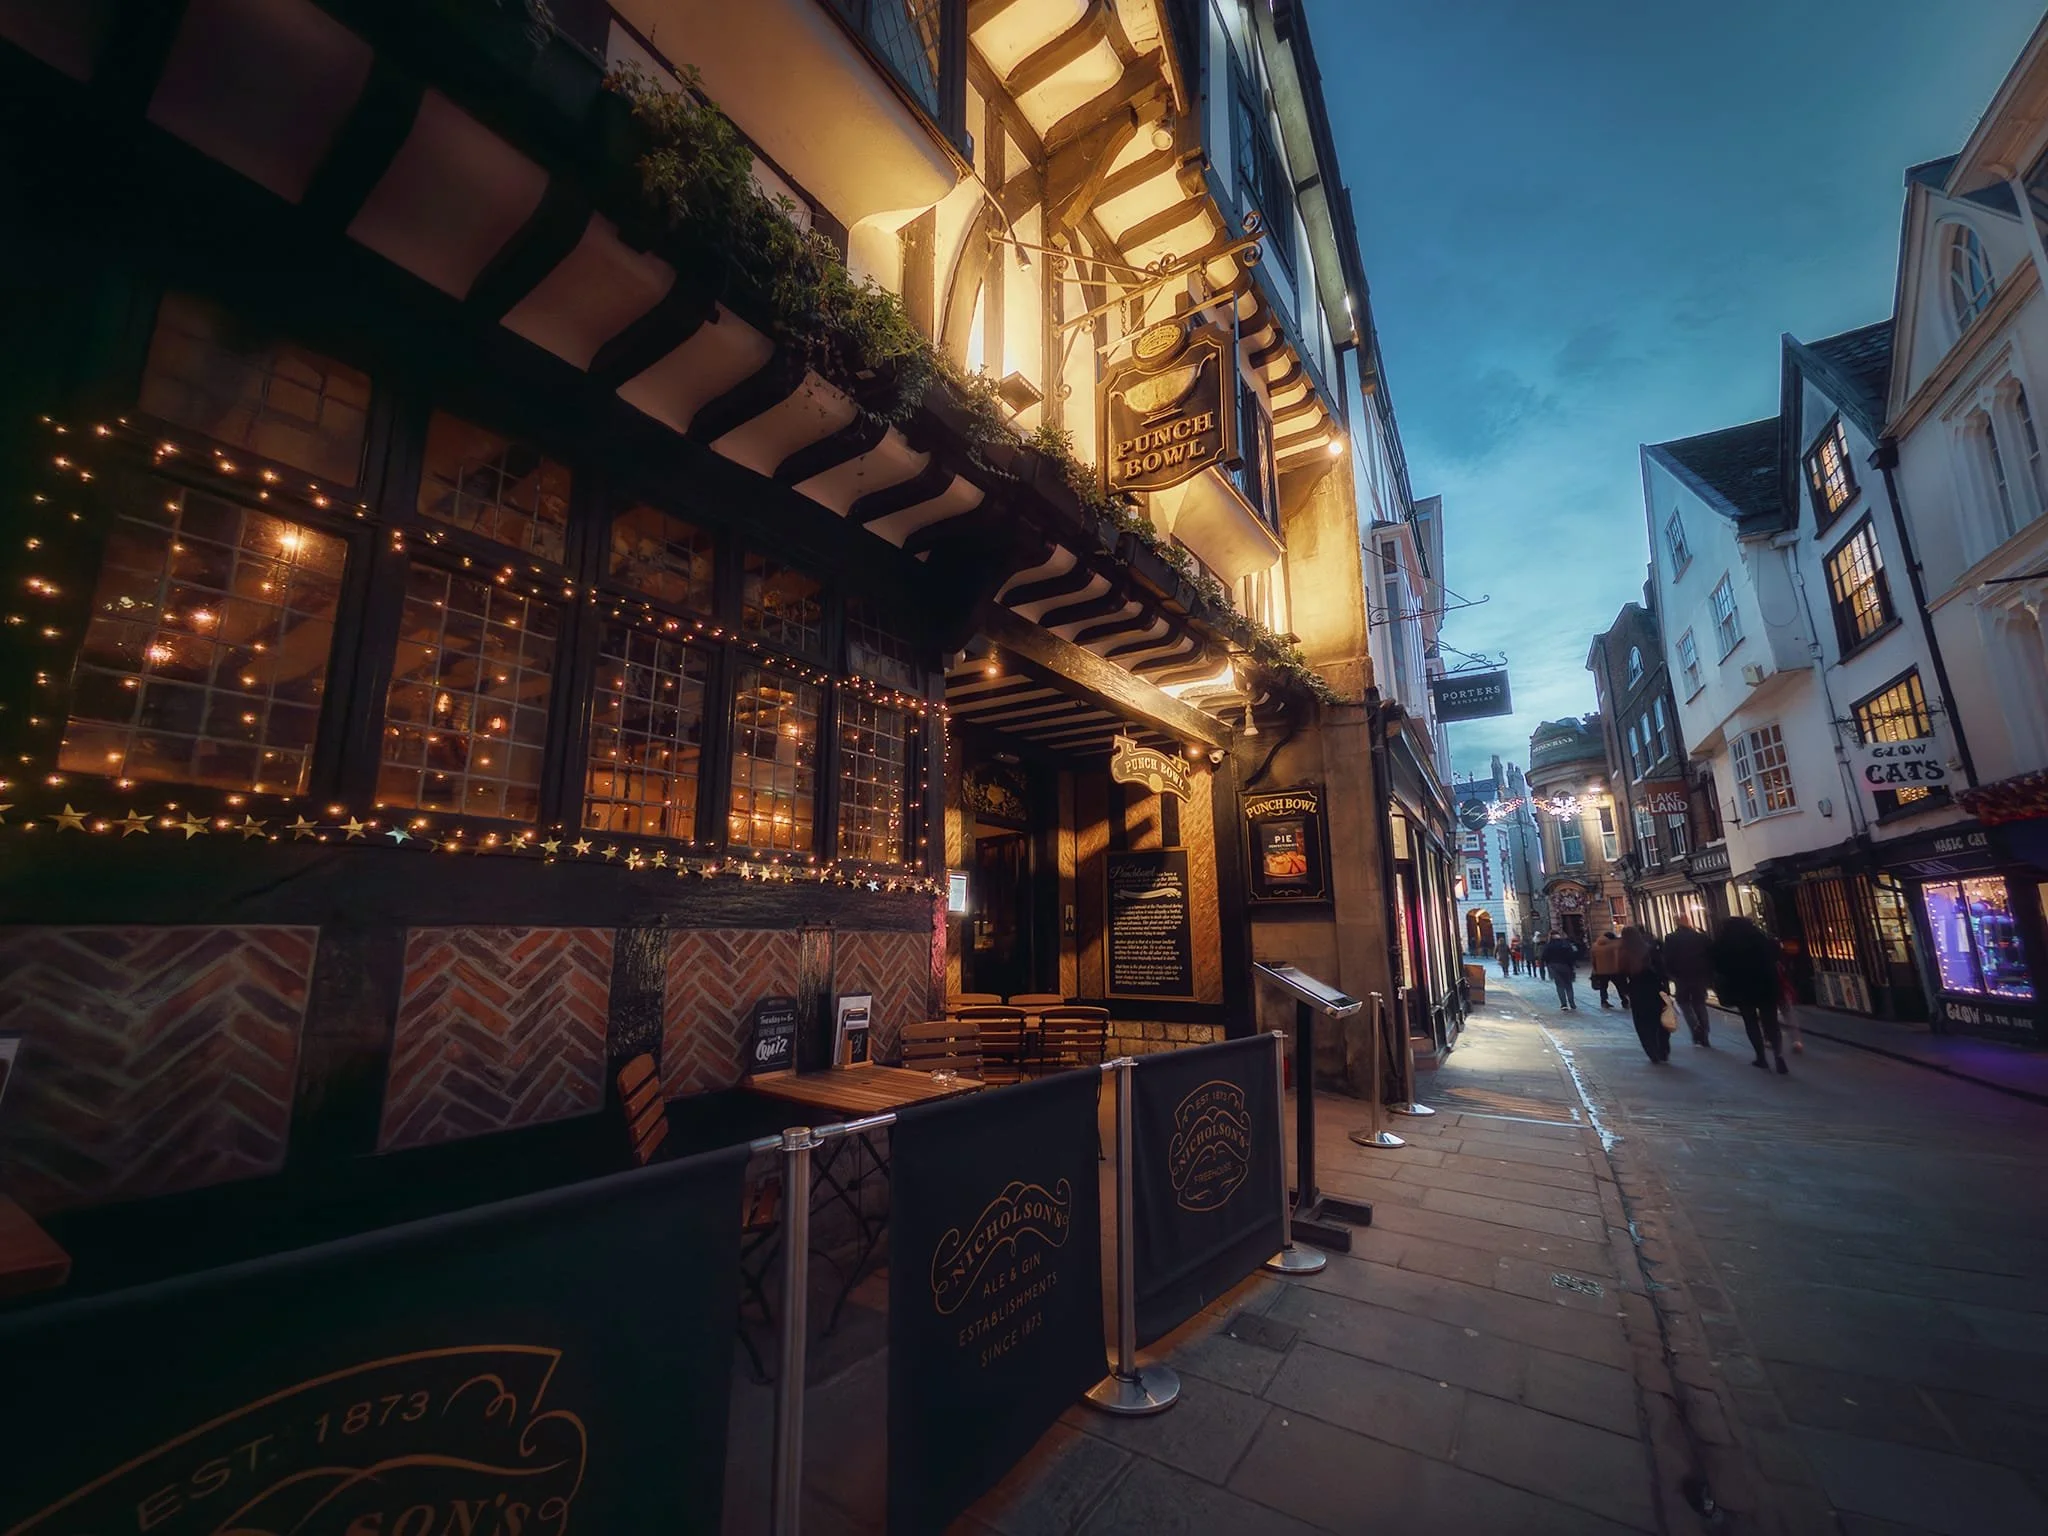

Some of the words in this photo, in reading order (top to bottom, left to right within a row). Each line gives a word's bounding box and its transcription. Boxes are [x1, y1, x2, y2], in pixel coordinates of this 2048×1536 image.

[1115, 409, 1214, 460] PUNCH
[1124, 439, 1206, 479] BOWL
[1442, 685, 1501, 701] PORTERS
[1872, 743, 1927, 758] GLOW
[1124, 757, 1158, 773] PUNCH
[1160, 762, 1185, 791] BOWL
[1865, 760, 1945, 784] CATS
[1245, 798, 1283, 818] PUNCH
[1284, 798, 1318, 813] BOWL
[1648, 791, 1681, 804] LAKE
[1650, 800, 1688, 813] LAND
[1274, 834, 1293, 844] PIE
[1967, 832, 1989, 847] CAT
[1694, 851, 1728, 871] LAKELAN
[1946, 1002, 1981, 1025] GLOW
[1178, 1123, 1246, 1172] NICHOLSON'S
[950, 1201, 1062, 1288] NICHOLSON'S
[983, 1272, 1006, 1299] ALE
[1009, 1265, 1017, 1282] &
[1021, 1250, 1041, 1275] GIN
[958, 1271, 1058, 1347] ESTABLISHMENTS
[981, 1329, 1018, 1368] SINCE
[1021, 1311, 1043, 1338] 1873
[315, 1389, 431, 1444] 1873
